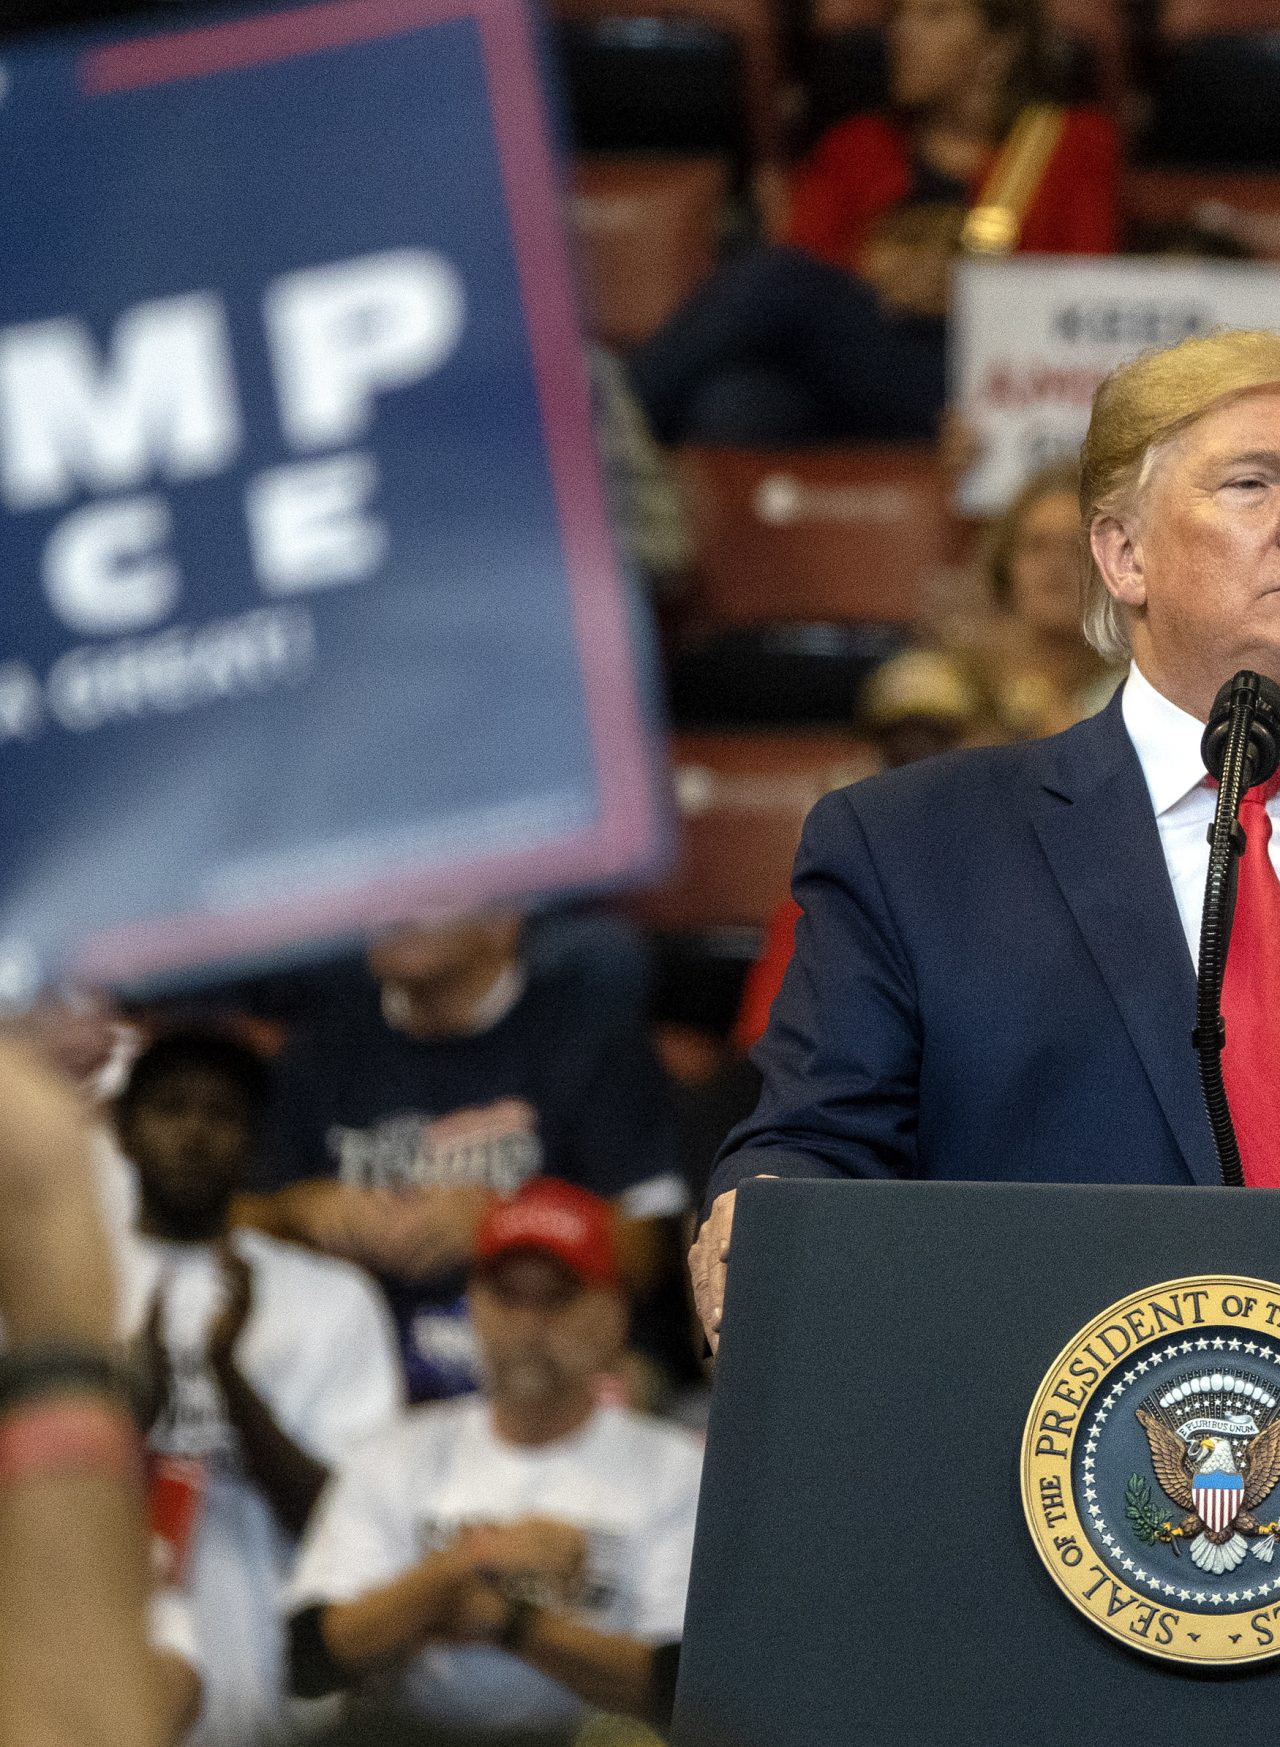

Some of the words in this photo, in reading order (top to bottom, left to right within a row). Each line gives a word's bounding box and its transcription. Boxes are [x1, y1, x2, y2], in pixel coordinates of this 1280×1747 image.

[1221, 1294, 1258, 1318] OF
[1036, 1290, 1209, 1460] PRESIDENT
[1179, 1428, 1187, 1438] E
[1185, 1419, 1229, 1432] PLURIBUS
[1229, 1425, 1256, 1434] UNUM
[1038, 1474, 1067, 1528] THE
[1053, 1534, 1083, 1568] OF
[1081, 1565, 1180, 1646] SEAL
